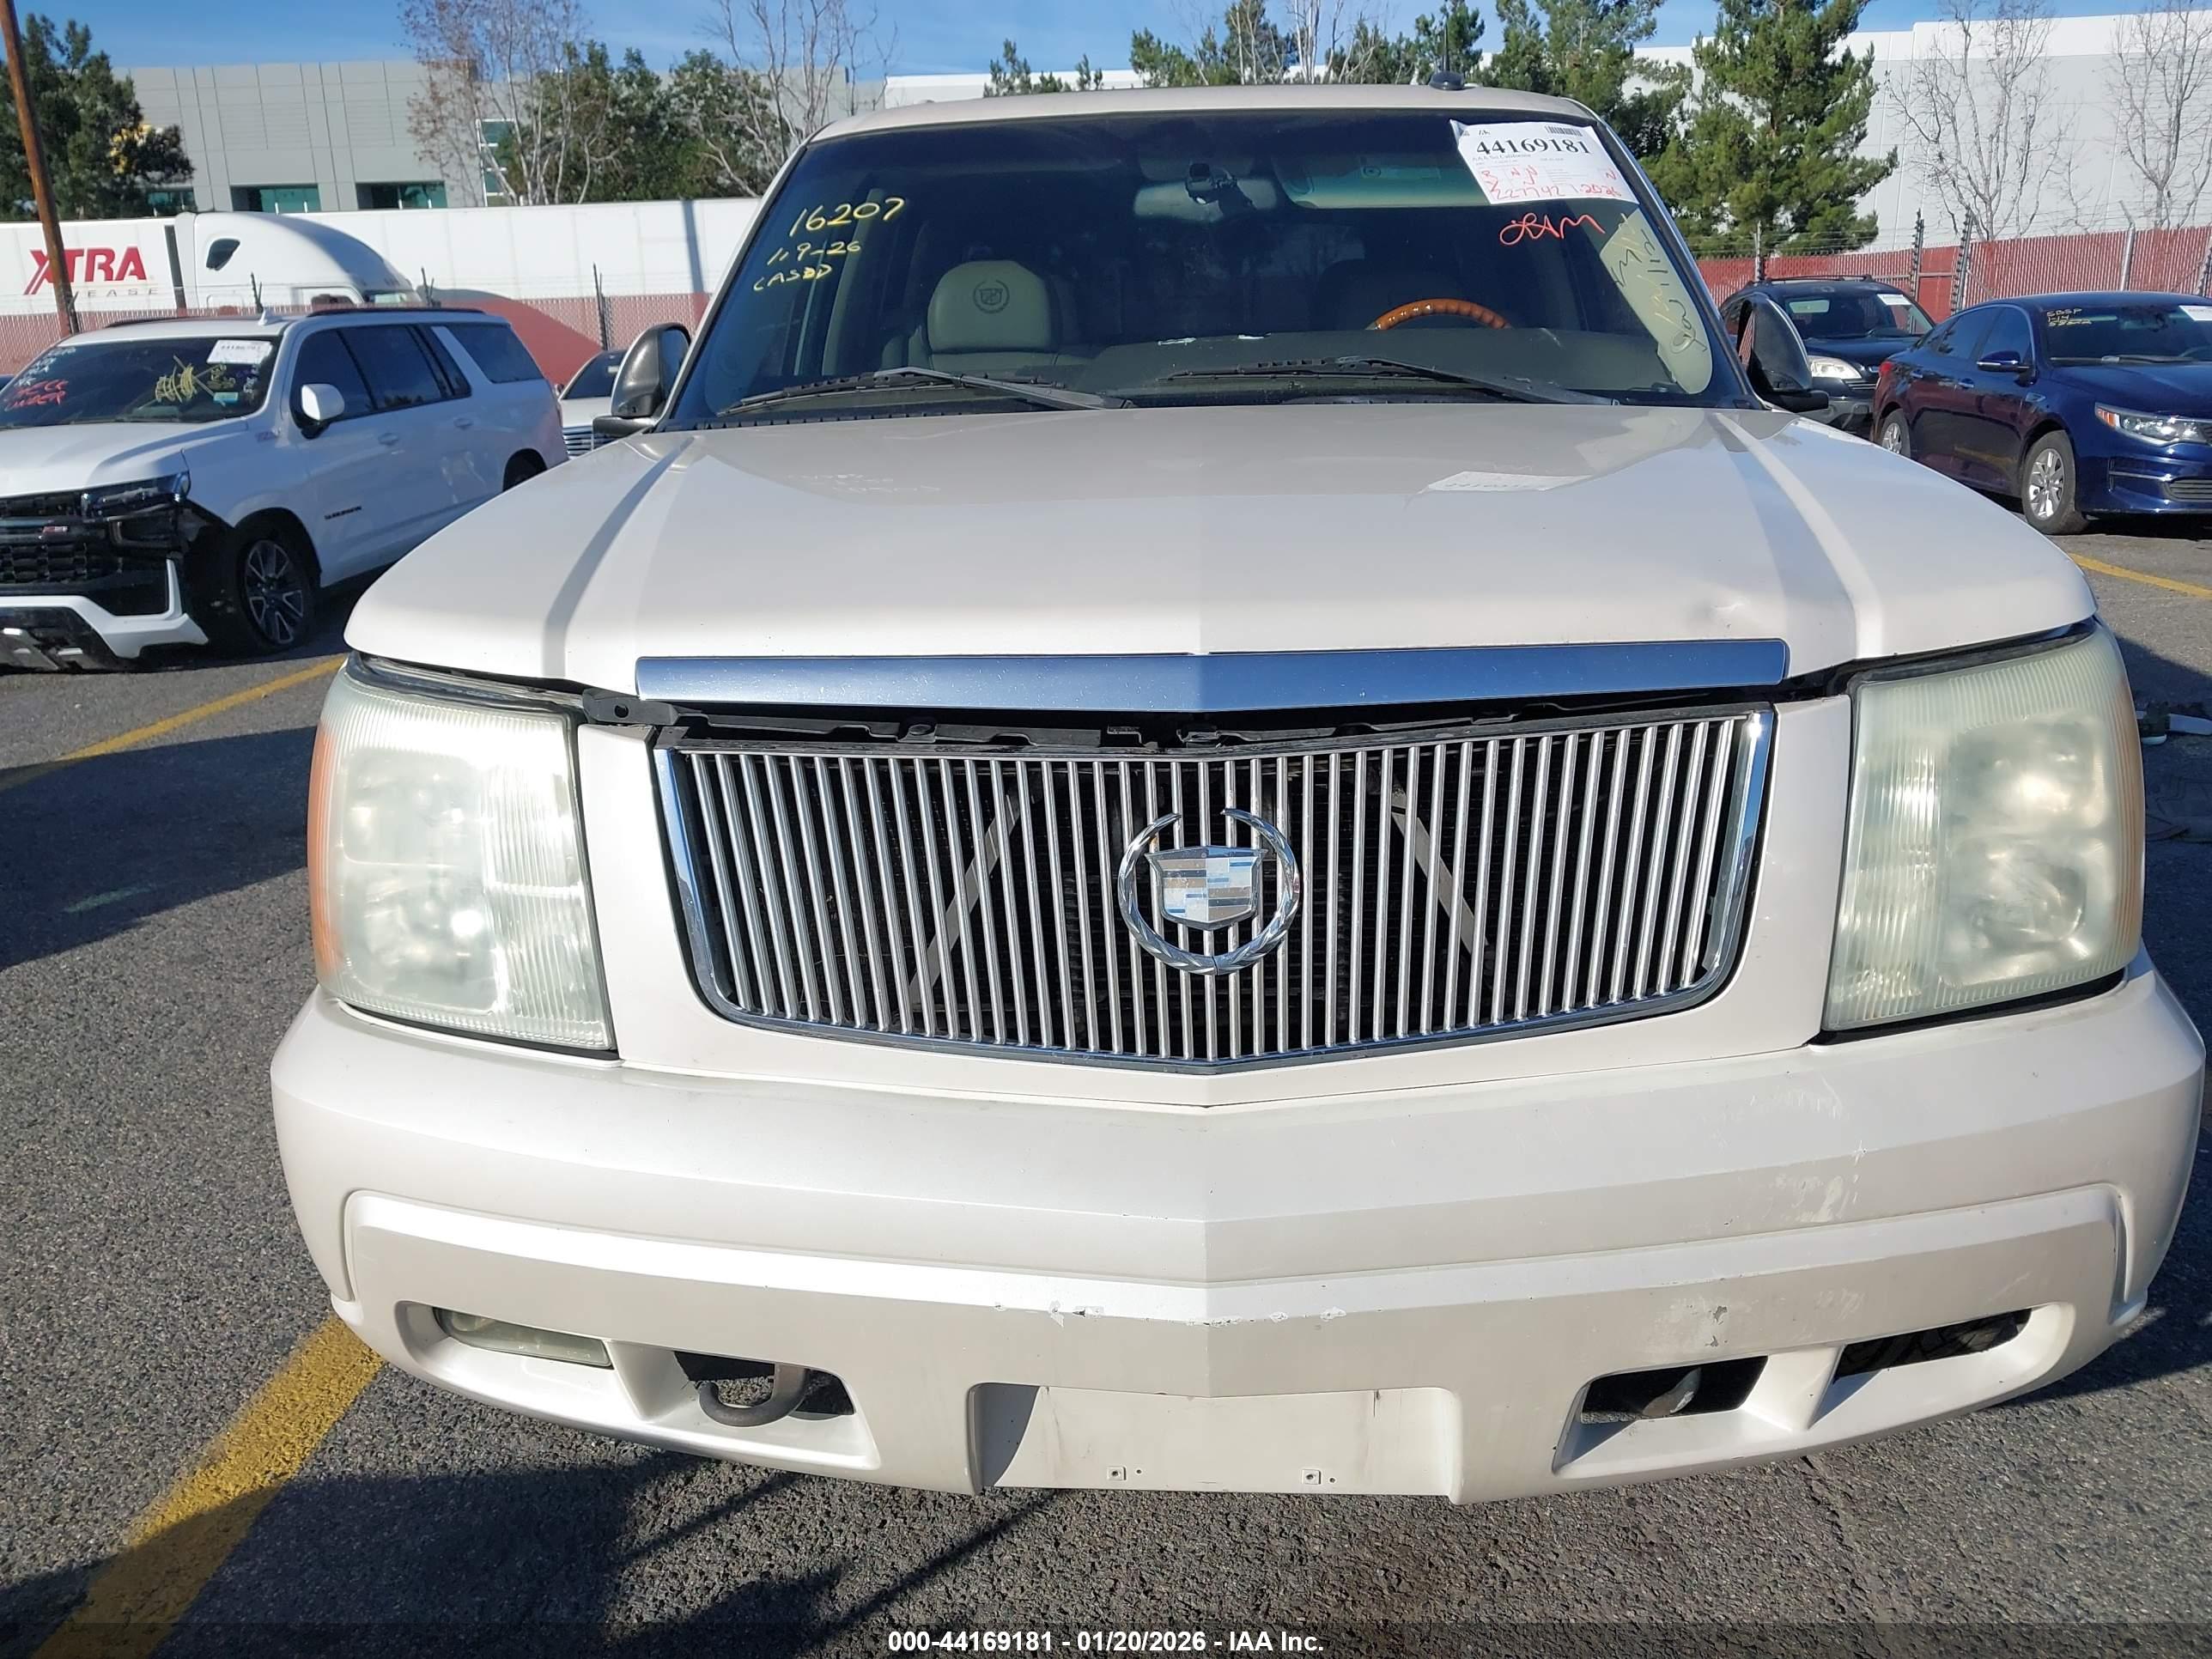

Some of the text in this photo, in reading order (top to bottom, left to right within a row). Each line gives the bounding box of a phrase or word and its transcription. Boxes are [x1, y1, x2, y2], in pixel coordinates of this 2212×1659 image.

[1476, 137, 1591, 155] 44169181
[789, 198, 904, 237] 16207
[23, 246, 148, 295] XTRA
